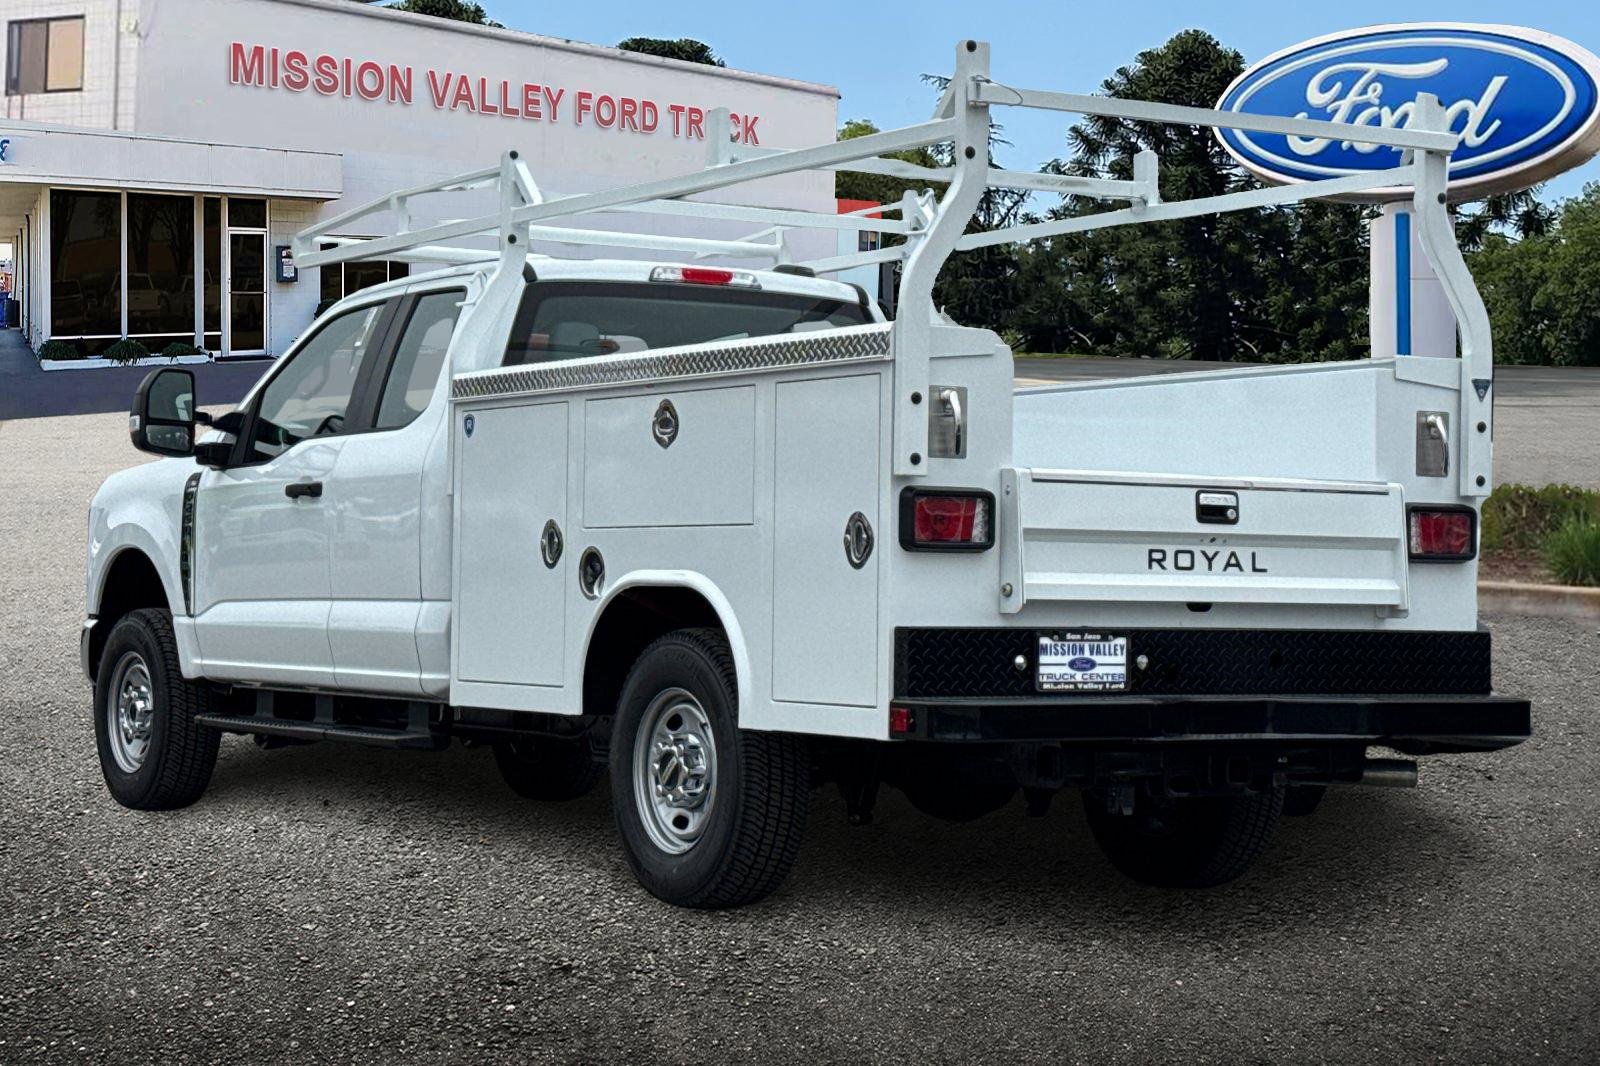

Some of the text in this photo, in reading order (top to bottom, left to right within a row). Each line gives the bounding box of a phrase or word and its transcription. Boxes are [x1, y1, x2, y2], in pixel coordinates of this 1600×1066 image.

[230, 42, 760, 145] MISSION VALLEY FORD TRCK
[1148, 549, 1268, 573] ROYAL
[1040, 643, 1125, 656] MISSION VALLEY
[1073, 659, 1092, 669] Ford
[1040, 673, 1125, 681] TRUCK CENTER
[1077, 682, 1103, 690] Valley
